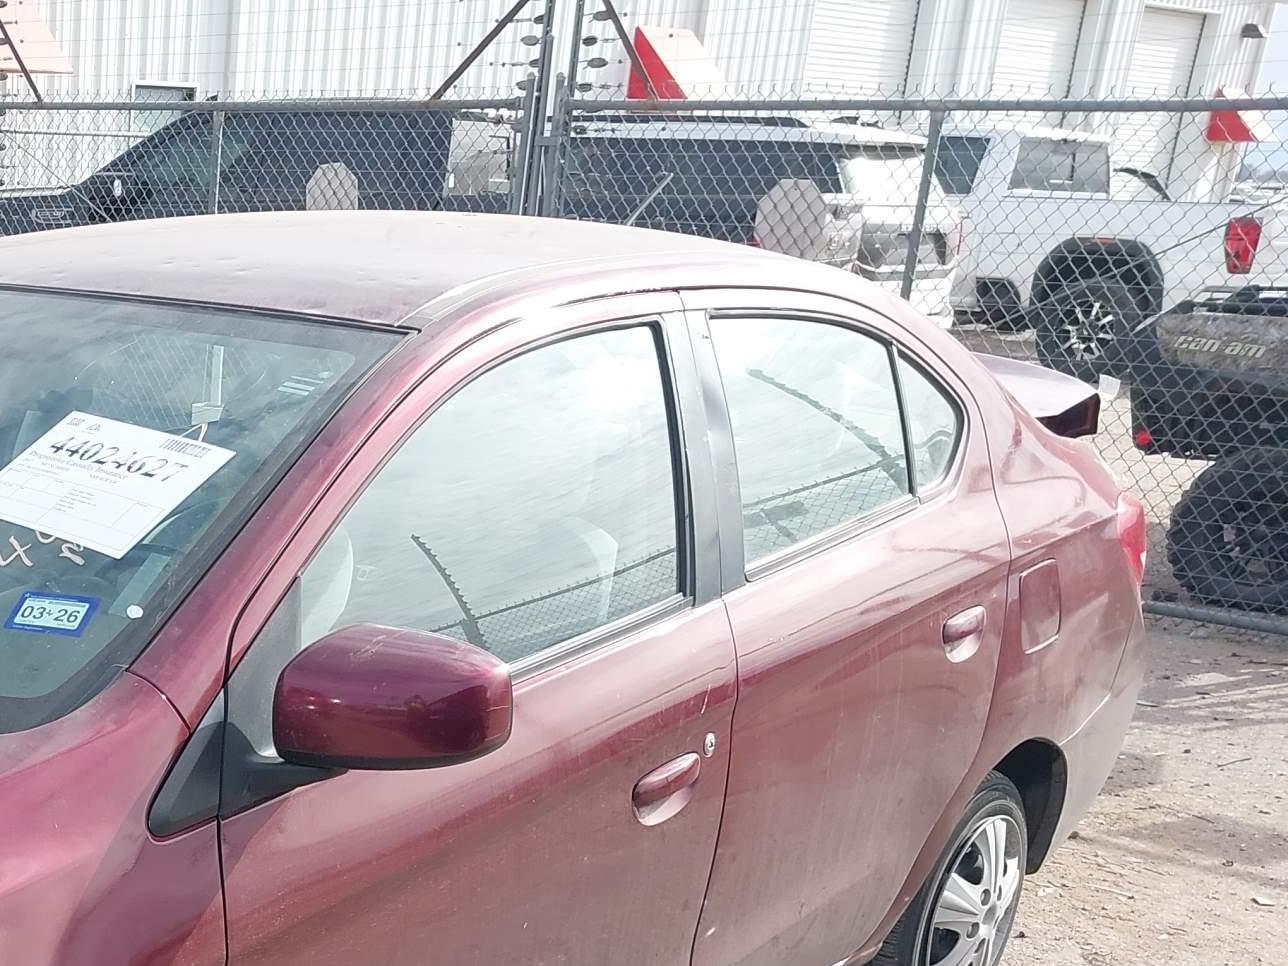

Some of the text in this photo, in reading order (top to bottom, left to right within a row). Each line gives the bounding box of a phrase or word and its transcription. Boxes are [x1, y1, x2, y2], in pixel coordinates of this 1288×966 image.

[49, 436, 189, 482] 44024627
[20, 605, 81, 623] 03 26
